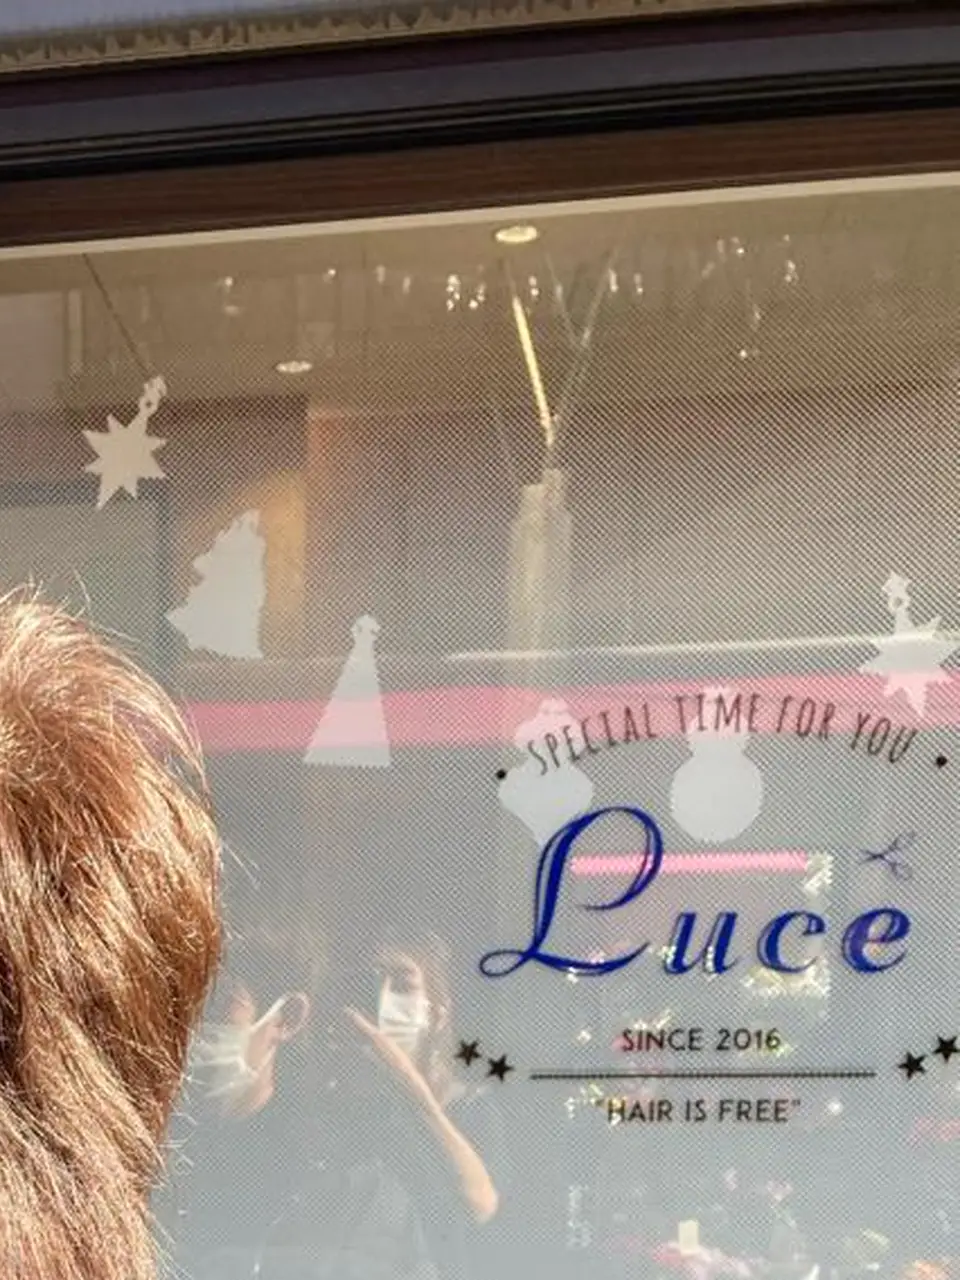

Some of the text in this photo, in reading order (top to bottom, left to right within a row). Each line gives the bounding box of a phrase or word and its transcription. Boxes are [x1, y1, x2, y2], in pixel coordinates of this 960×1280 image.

[526, 692, 918, 776] SPECIAL TIME FOR YOU
[478, 805, 913, 978] Luce
[620, 1028, 781, 1051] SINCE 2016
[684, 1099, 707, 1123] IS
